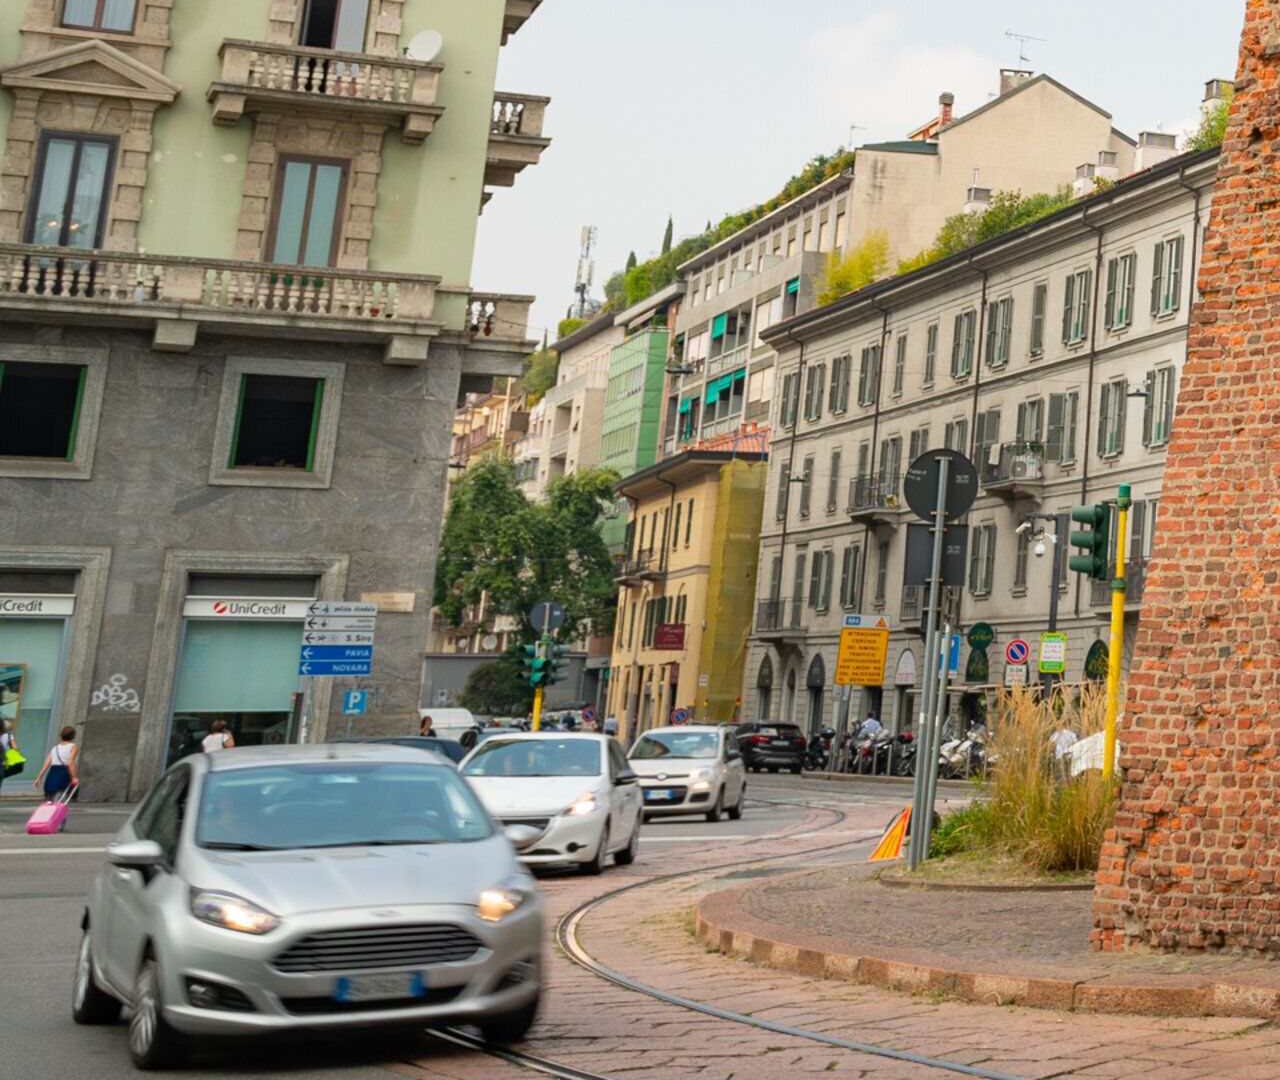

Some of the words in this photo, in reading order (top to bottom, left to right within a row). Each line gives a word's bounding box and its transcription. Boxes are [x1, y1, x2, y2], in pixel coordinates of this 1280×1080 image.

[229, 603, 287, 615] UniCredit
[345, 649, 370, 657] PAVIA
[332, 664, 368, 672] NOVARA
[349, 692, 362, 708] P
